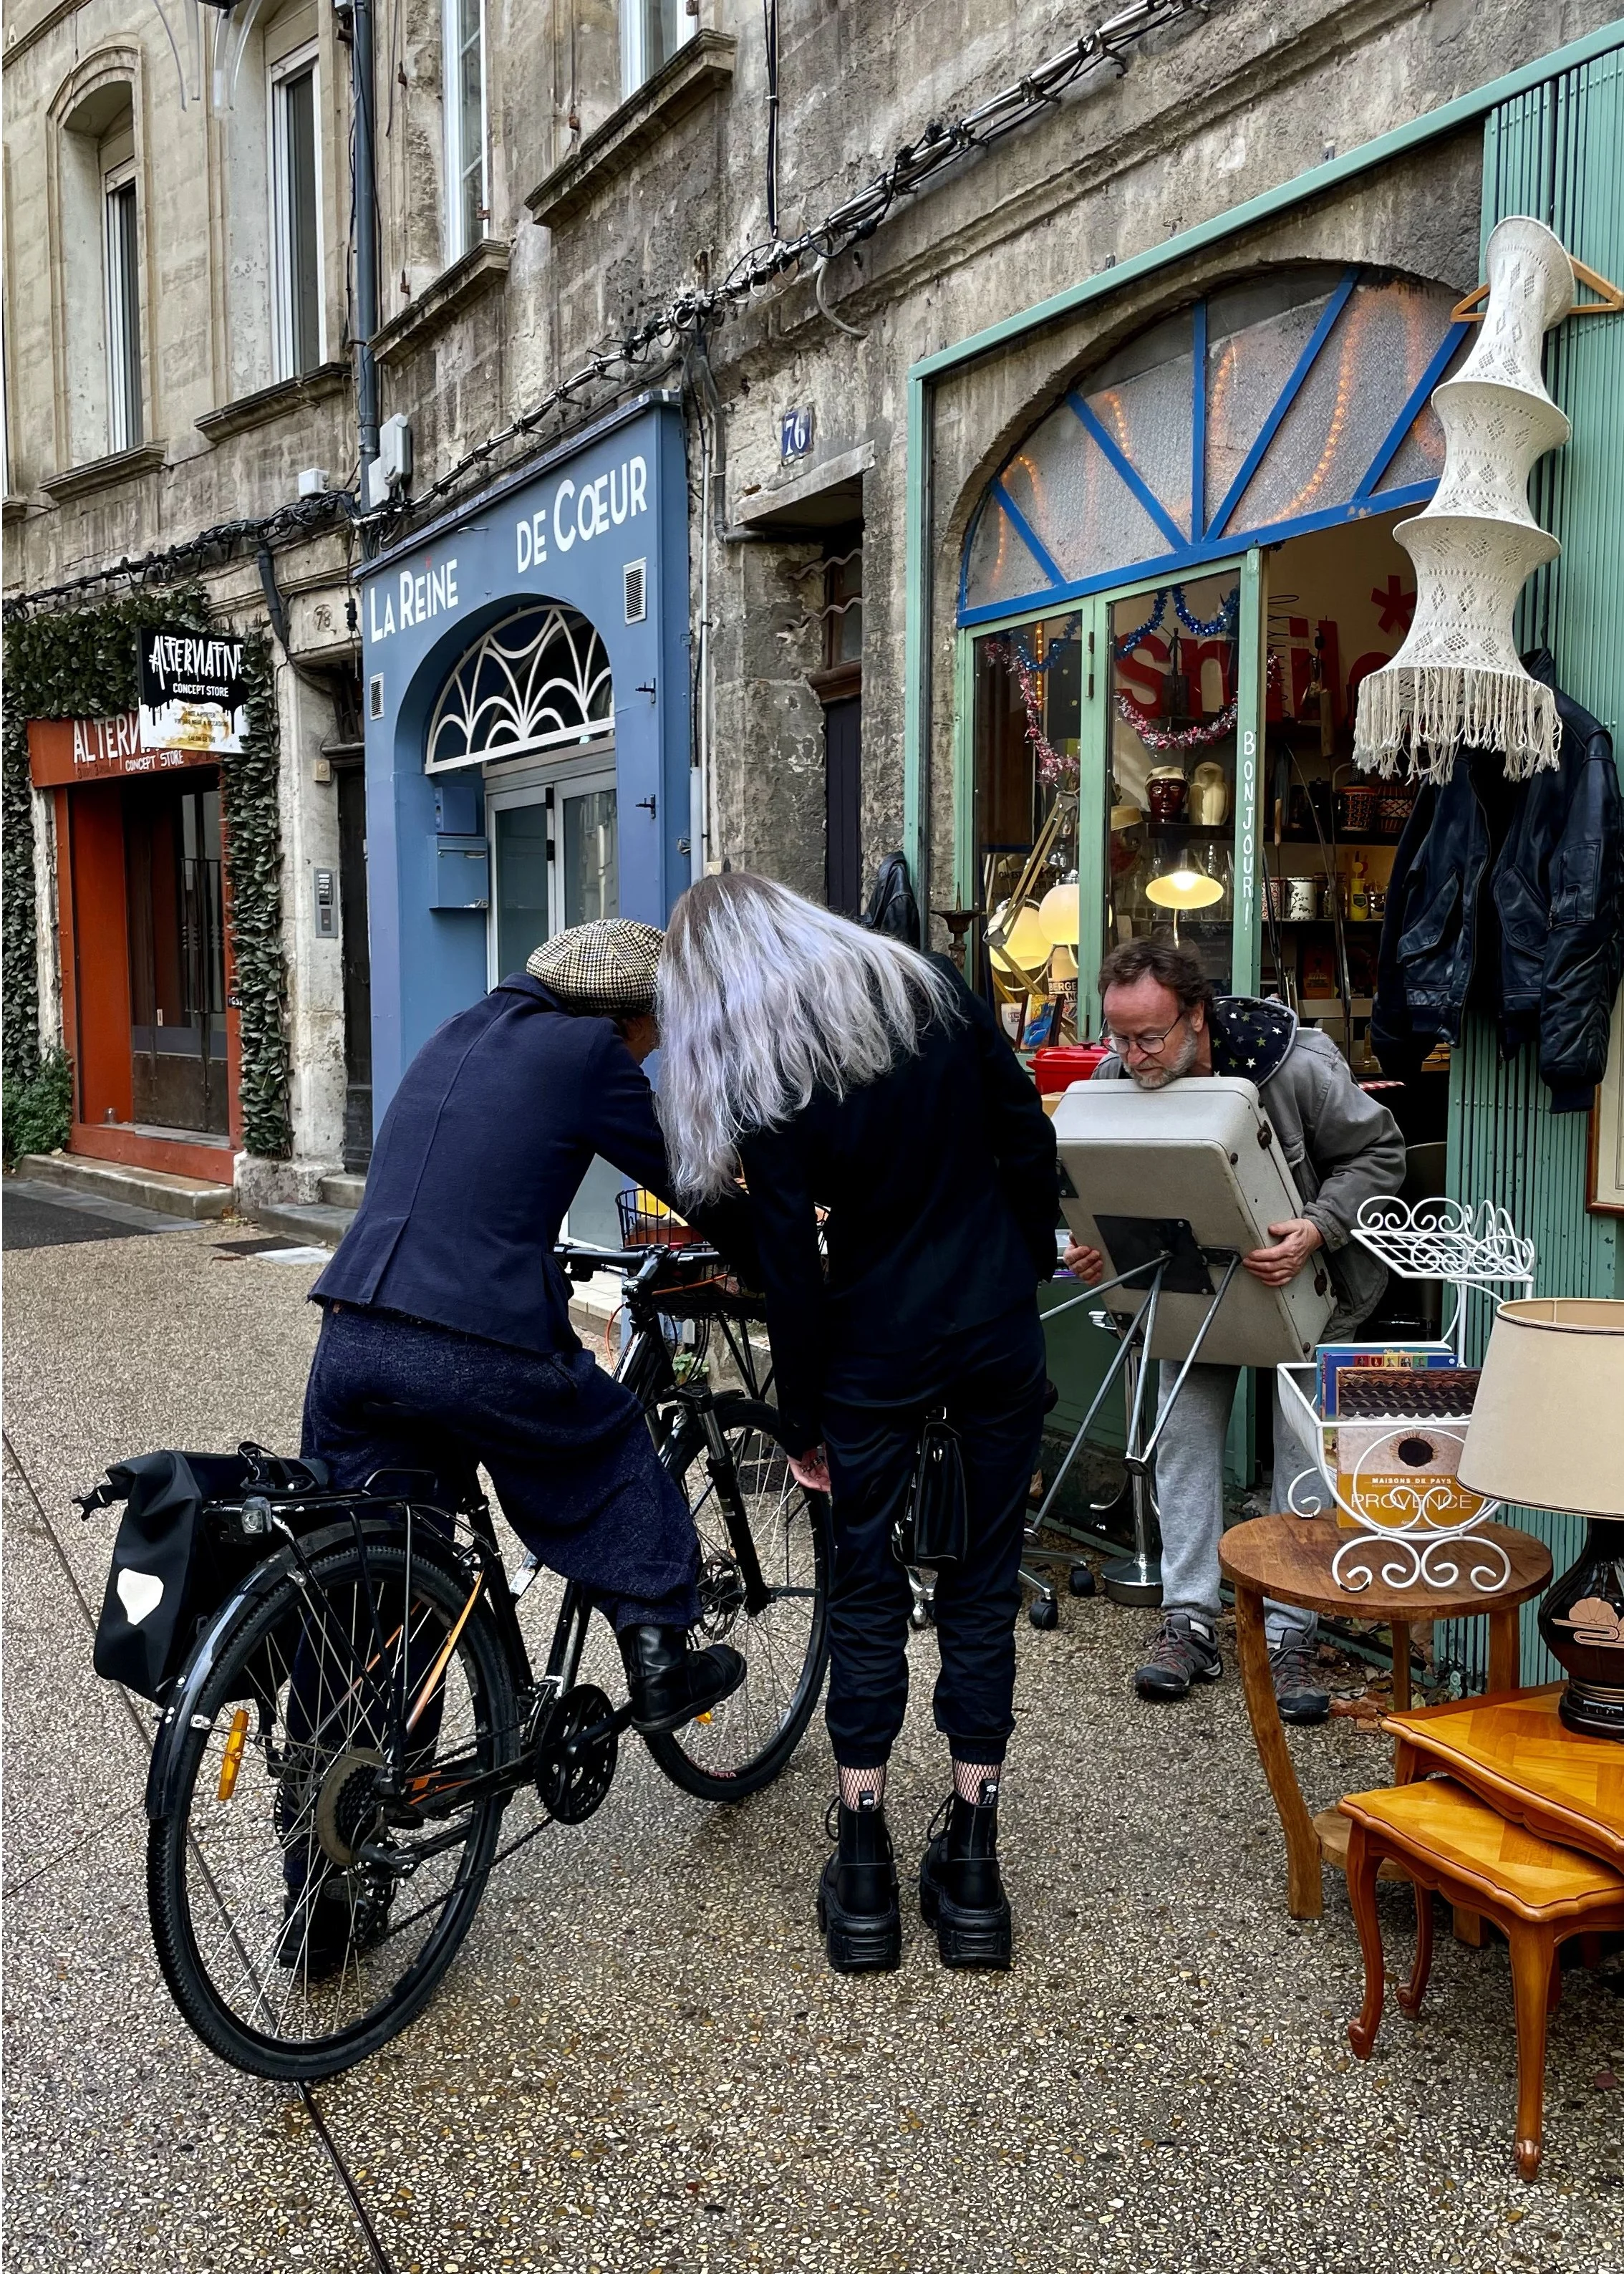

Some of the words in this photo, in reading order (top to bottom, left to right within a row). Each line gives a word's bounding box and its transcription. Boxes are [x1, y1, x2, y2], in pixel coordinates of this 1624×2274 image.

[785, 416, 806, 456] 76
[369, 587, 396, 644] LA
[400, 558, 459, 630] REINE
[516, 509, 547, 573] DE
[554, 456, 647, 552] CŒUR
[316, 610, 330, 630] 78
[173, 683, 205, 695] CONCEPT
[206, 685, 229, 698] STORE
[125, 754, 156, 772] CONCEPT
[160, 750, 184, 767] STORE
[1048, 981, 1078, 991] BERGE
[1351, 1493, 1472, 1509] PROVENCE
